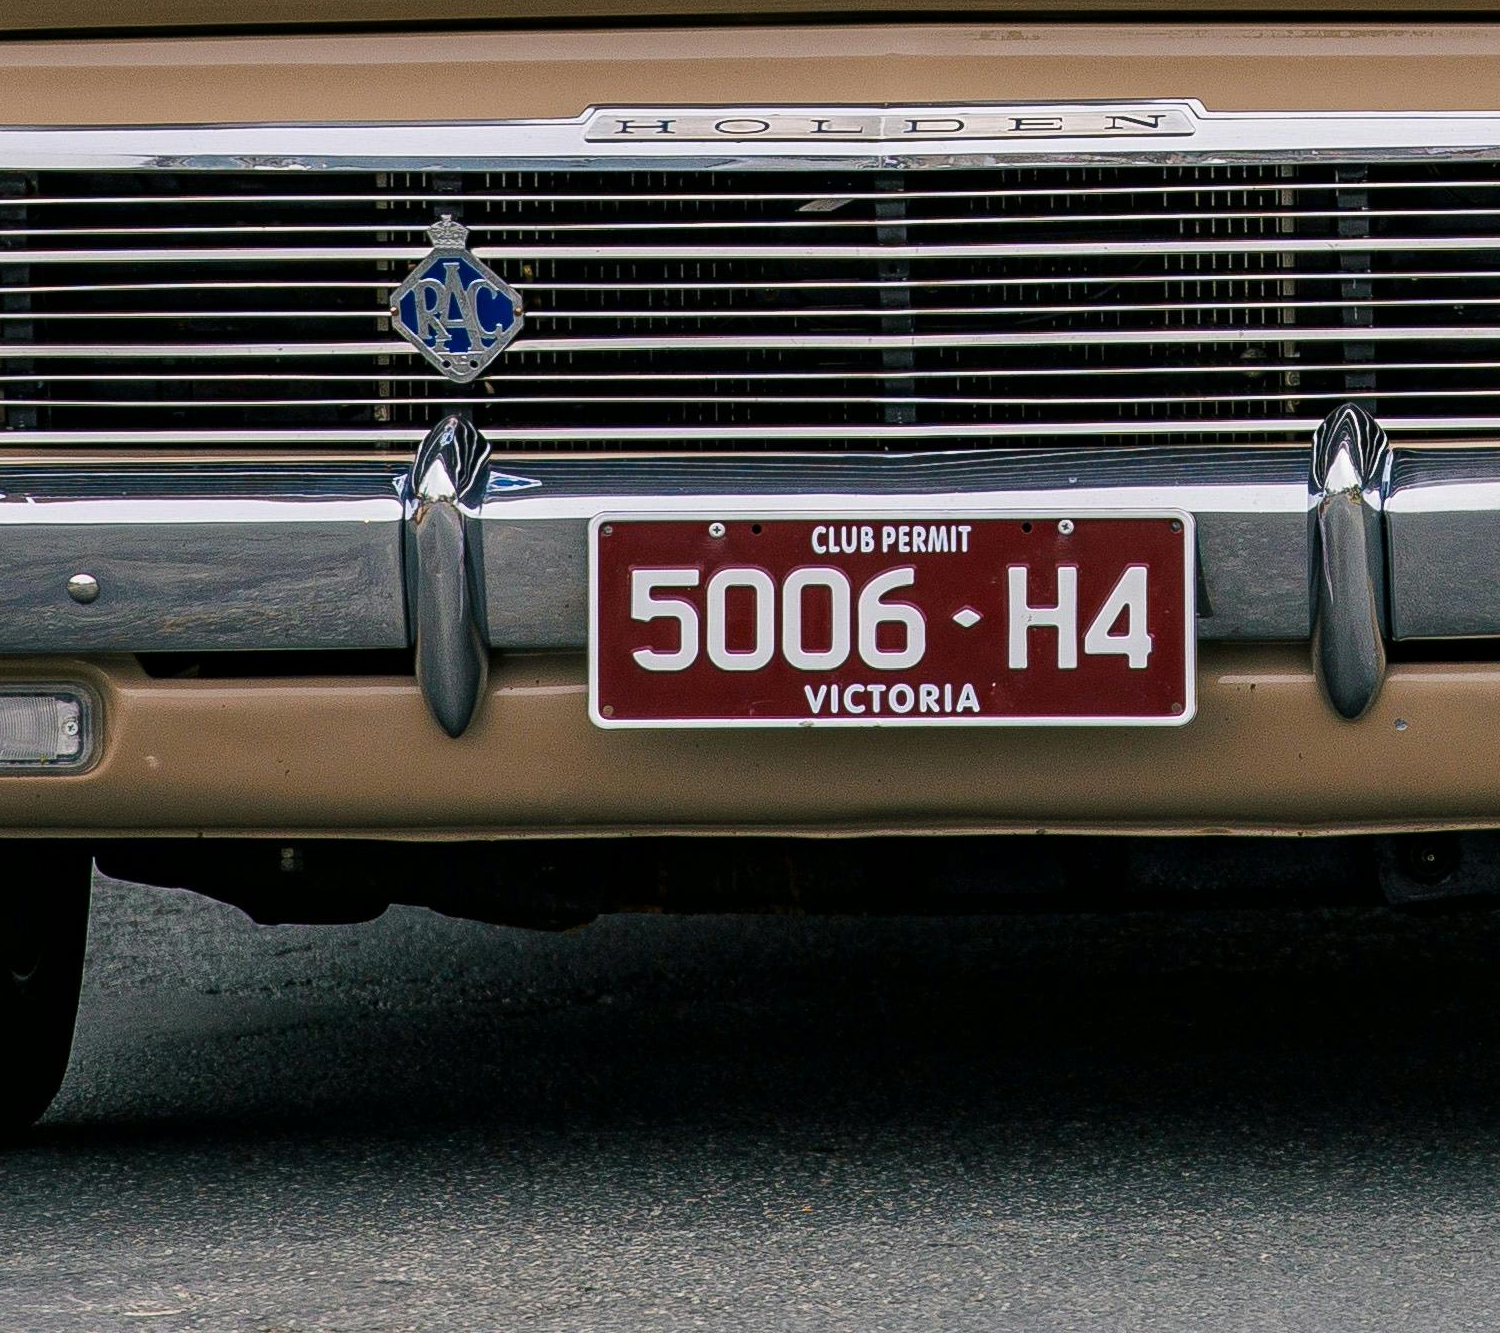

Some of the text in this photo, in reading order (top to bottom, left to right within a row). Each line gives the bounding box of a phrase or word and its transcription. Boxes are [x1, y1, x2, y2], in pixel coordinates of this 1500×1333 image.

[613, 114, 1167, 135] HOLDEN
[811, 525, 972, 554] CLUB PERMIT
[629, 564, 1154, 672] 5006 H4
[804, 684, 981, 715] VICTORIA
